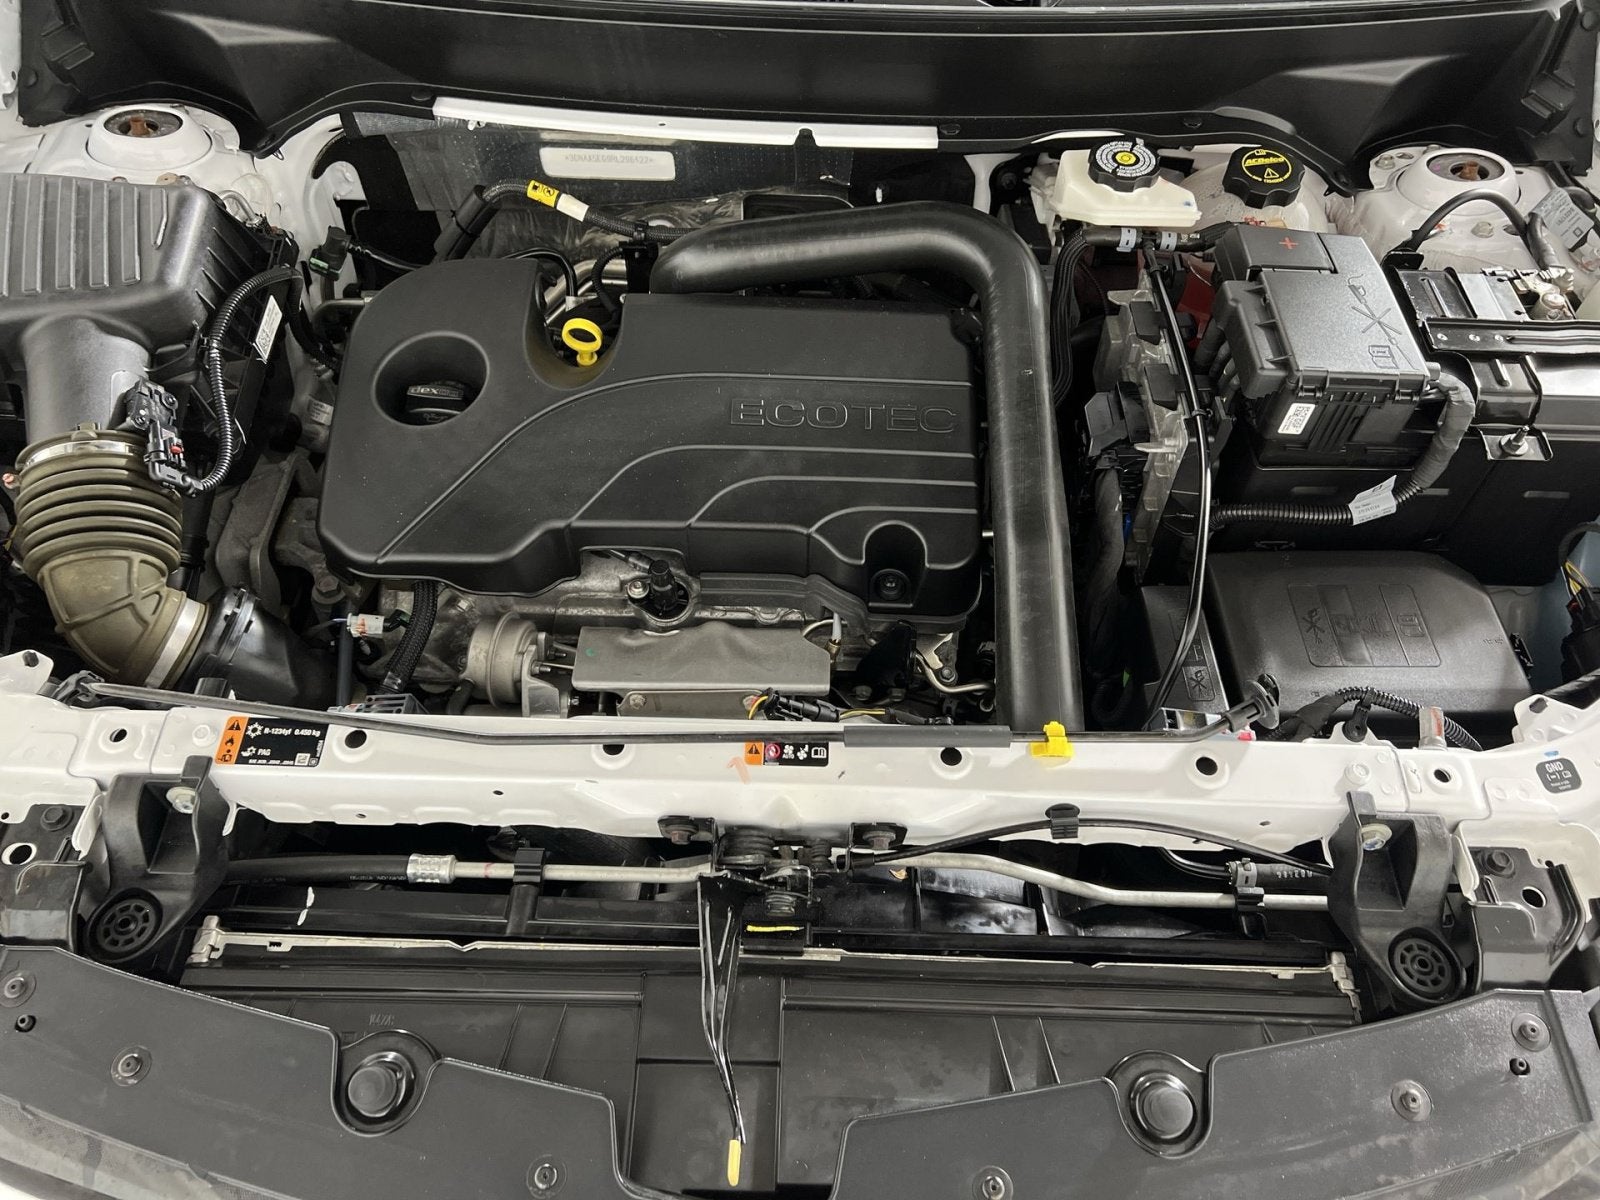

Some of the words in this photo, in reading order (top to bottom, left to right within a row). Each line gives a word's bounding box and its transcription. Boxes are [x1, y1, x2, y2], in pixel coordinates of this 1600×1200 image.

[1244, 156, 1285, 167] ACDelco
[730, 399, 957, 433] ECOTEC
[263, 727, 292, 737] R-1234yf
[294, 728, 312, 736] 0.450
[312, 729, 321, 738] kg
[257, 748, 271, 756] PAG
[1545, 761, 1564, 773] GND
